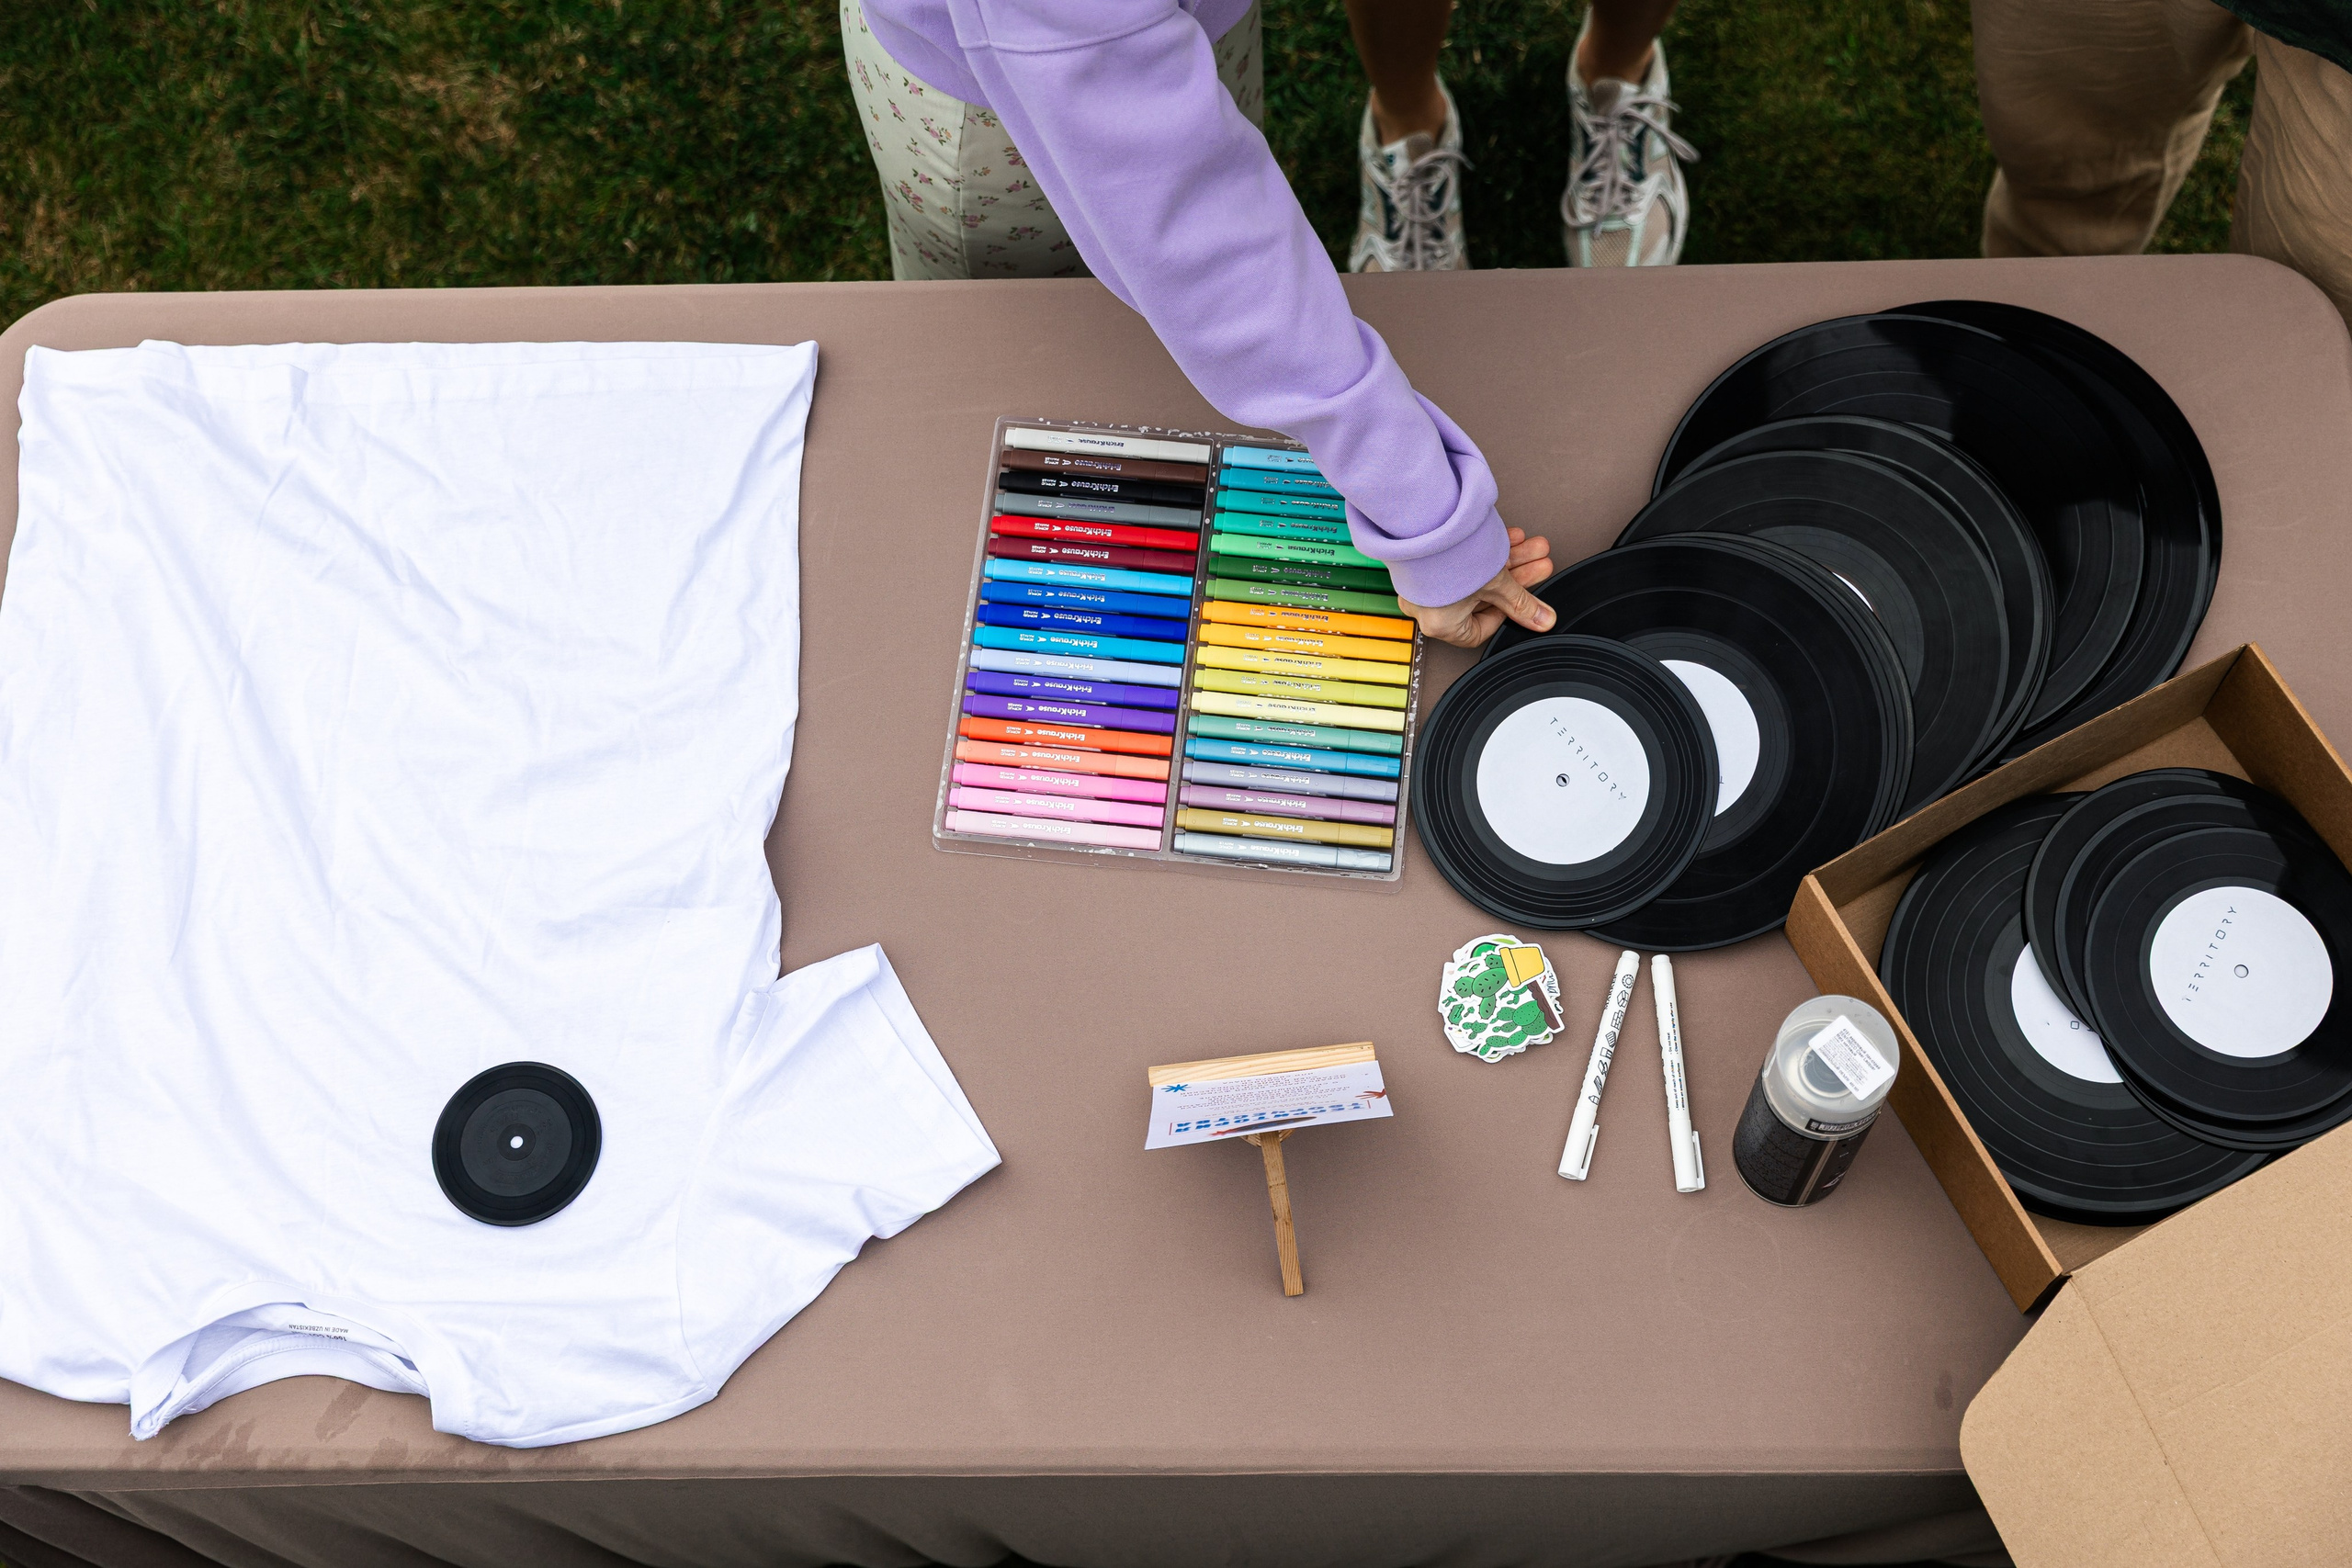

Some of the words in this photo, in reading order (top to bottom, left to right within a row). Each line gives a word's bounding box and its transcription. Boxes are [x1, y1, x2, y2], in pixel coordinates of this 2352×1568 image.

[1078, 438, 1124, 447] ErichKrause
[1074, 460, 1121, 471] ErichKrause
[1071, 481, 1119, 492] ErichKrause
[1065, 525, 1112, 536] ErichKrause
[1062, 547, 1109, 558] ErichKrause
[1288, 545, 1335, 556] ErichKrause
[1059, 570, 1105, 581] ErichKrause
[1058, 591, 1105, 602] ErichKrause
[1054, 613, 1102, 624] ErichKrause
[1050, 636, 1097, 648] ErichKrause
[1046, 659, 1093, 671] ErichKrause
[1045, 681, 1092, 693] ErichKrause
[1039, 705, 1086, 716] ErichKrause
[1037, 729, 1085, 741] ErichKrause
[1032, 751, 1080, 762] ErichKrause
[1262, 750, 1310, 761] ErichKrause
[1550, 717, 1626, 800] TERRITORY
[1031, 775, 1079, 786] ErichKrause
[1261, 772, 1310, 784] ErichKrause
[1026, 798, 1074, 810] ErichKrause
[1258, 796, 1306, 808] ErichKrause
[1023, 822, 1071, 834] ErichKrause
[1254, 820, 1303, 833] ErichKrause
[1251, 844, 1299, 856] ErichKrause
[2182, 907, 2236, 1001] TERRITORY
[1175, 1105, 1366, 1133] ТЕРРИТОРИЯ
